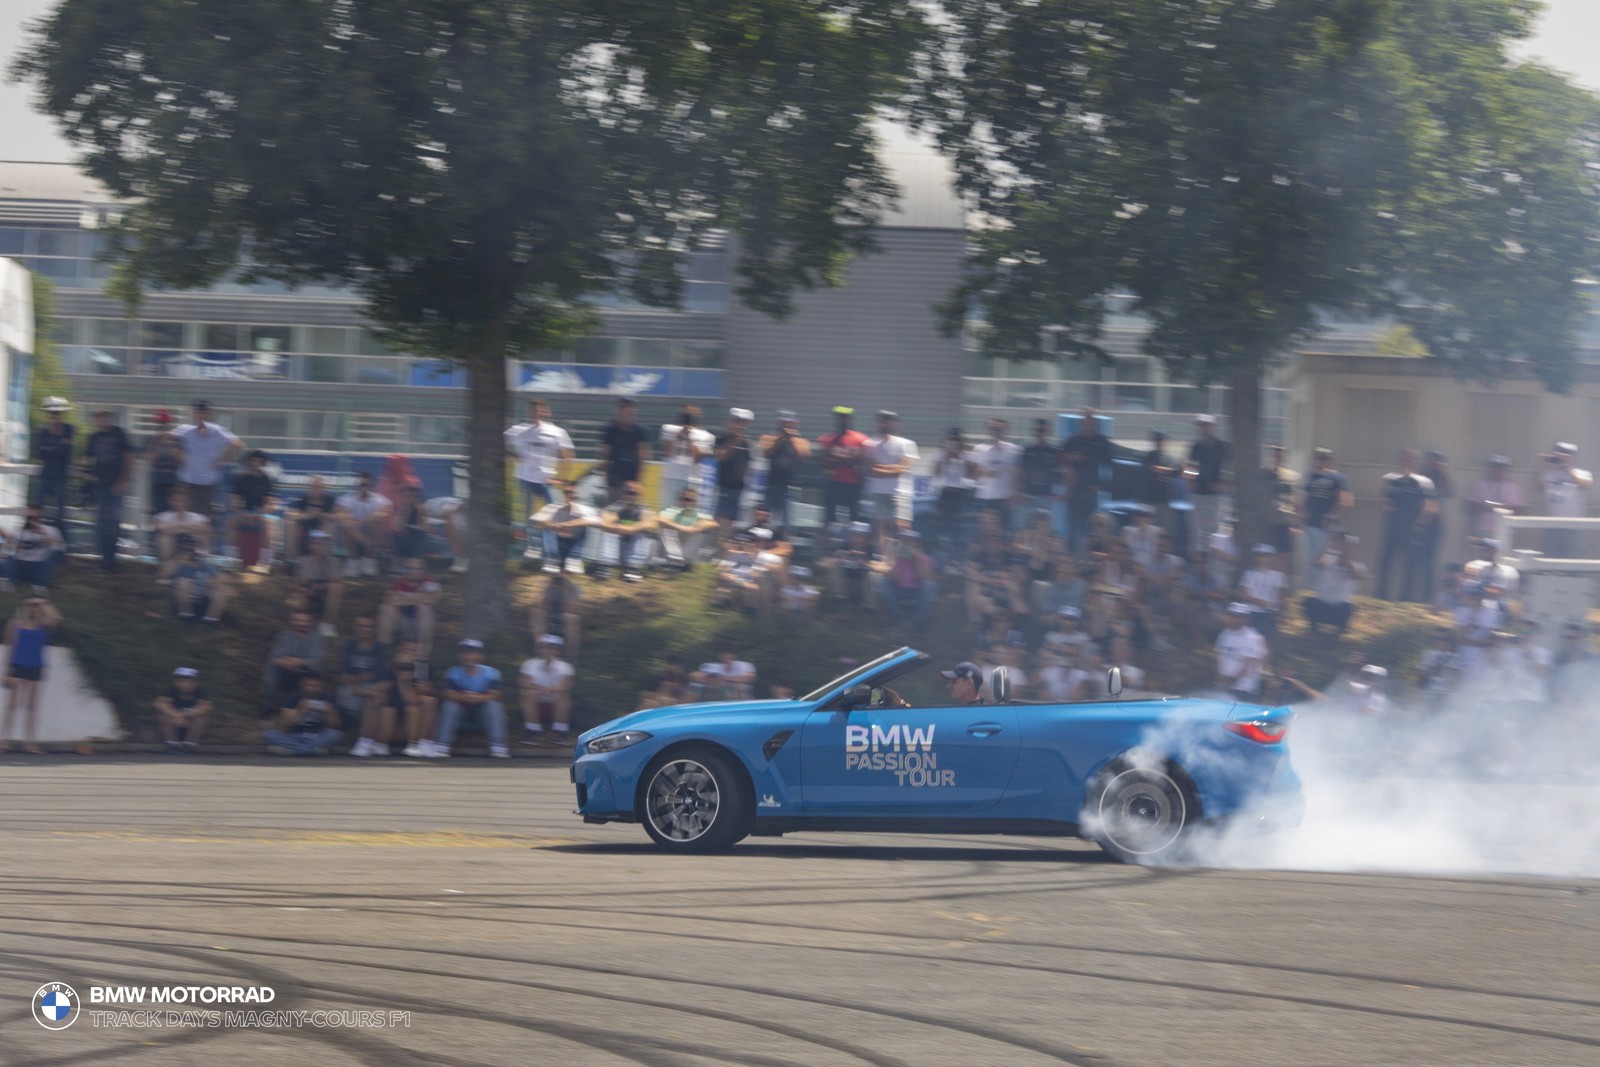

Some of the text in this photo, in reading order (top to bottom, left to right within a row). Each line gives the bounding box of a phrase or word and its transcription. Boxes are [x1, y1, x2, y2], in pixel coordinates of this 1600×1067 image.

[846, 724, 936, 752] BMW
[846, 752, 937, 772] PASSION
[894, 768, 956, 787] TOUR
